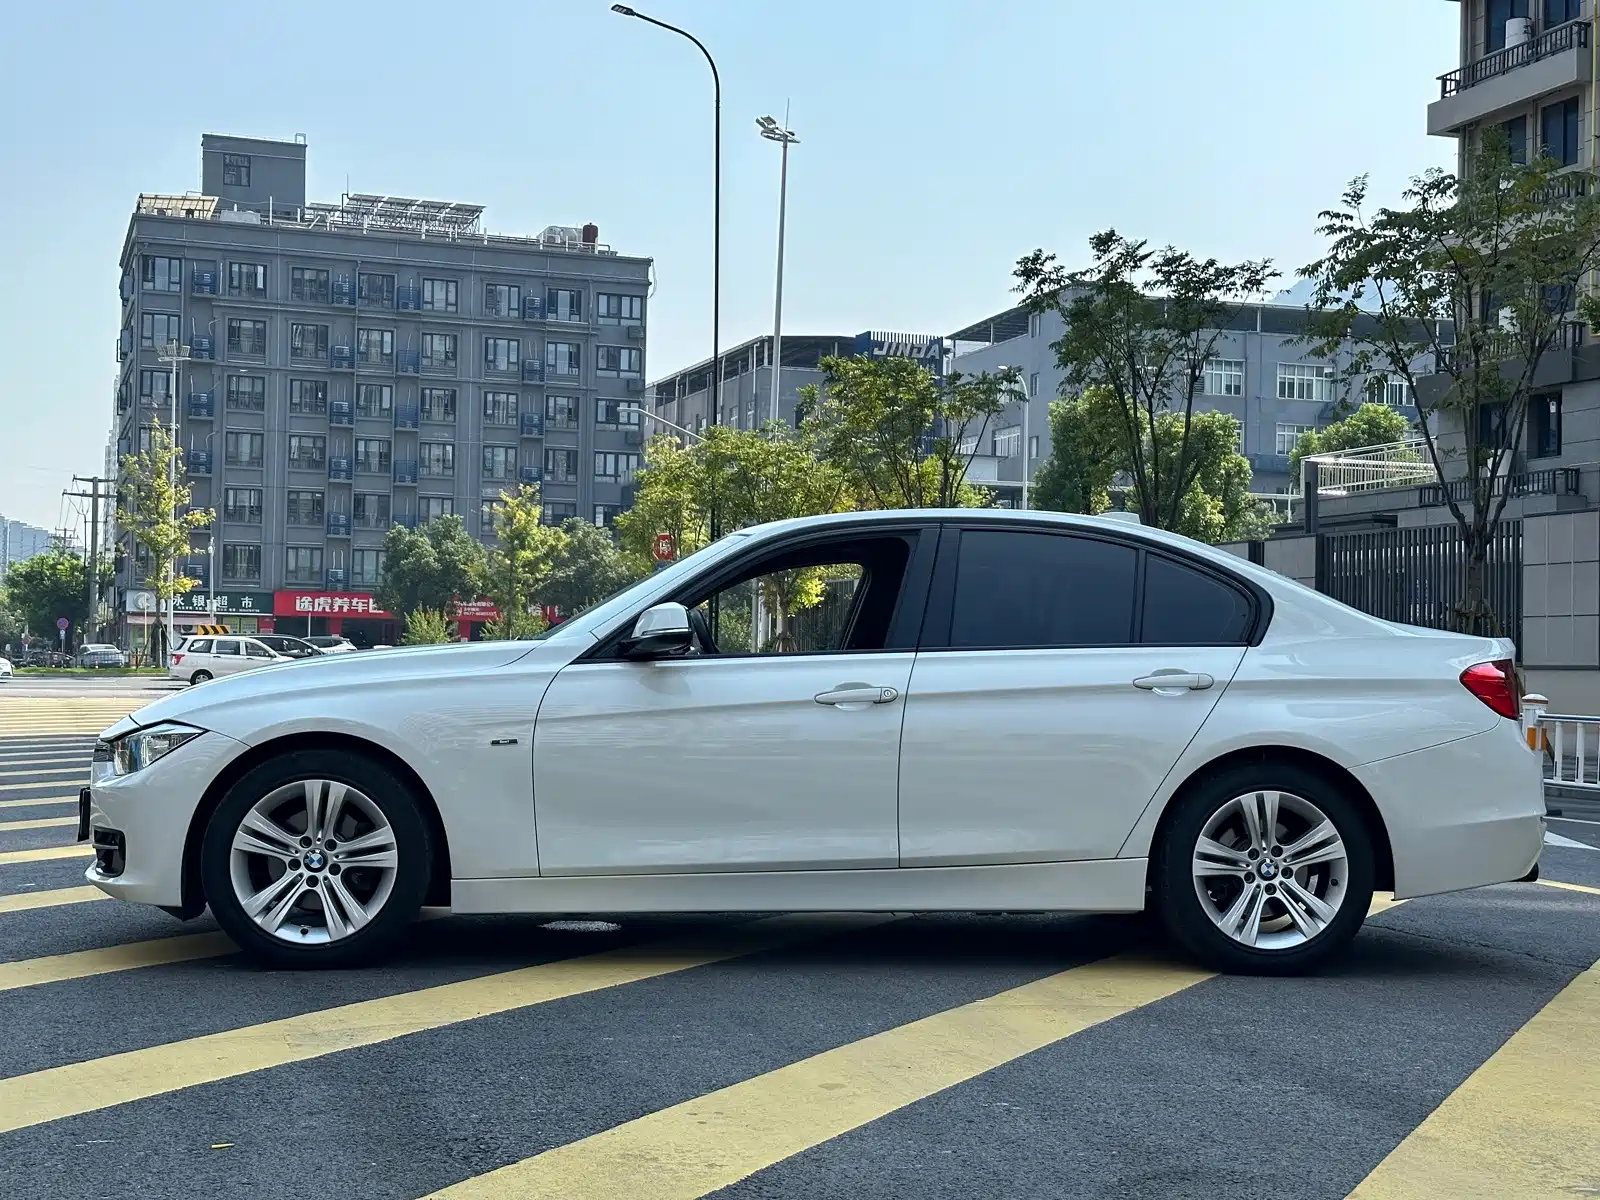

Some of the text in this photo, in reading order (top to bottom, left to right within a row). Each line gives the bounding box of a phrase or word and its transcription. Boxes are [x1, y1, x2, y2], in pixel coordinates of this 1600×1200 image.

[873, 341, 940, 360] JINDA
[173, 593, 254, 609] 永银超市
